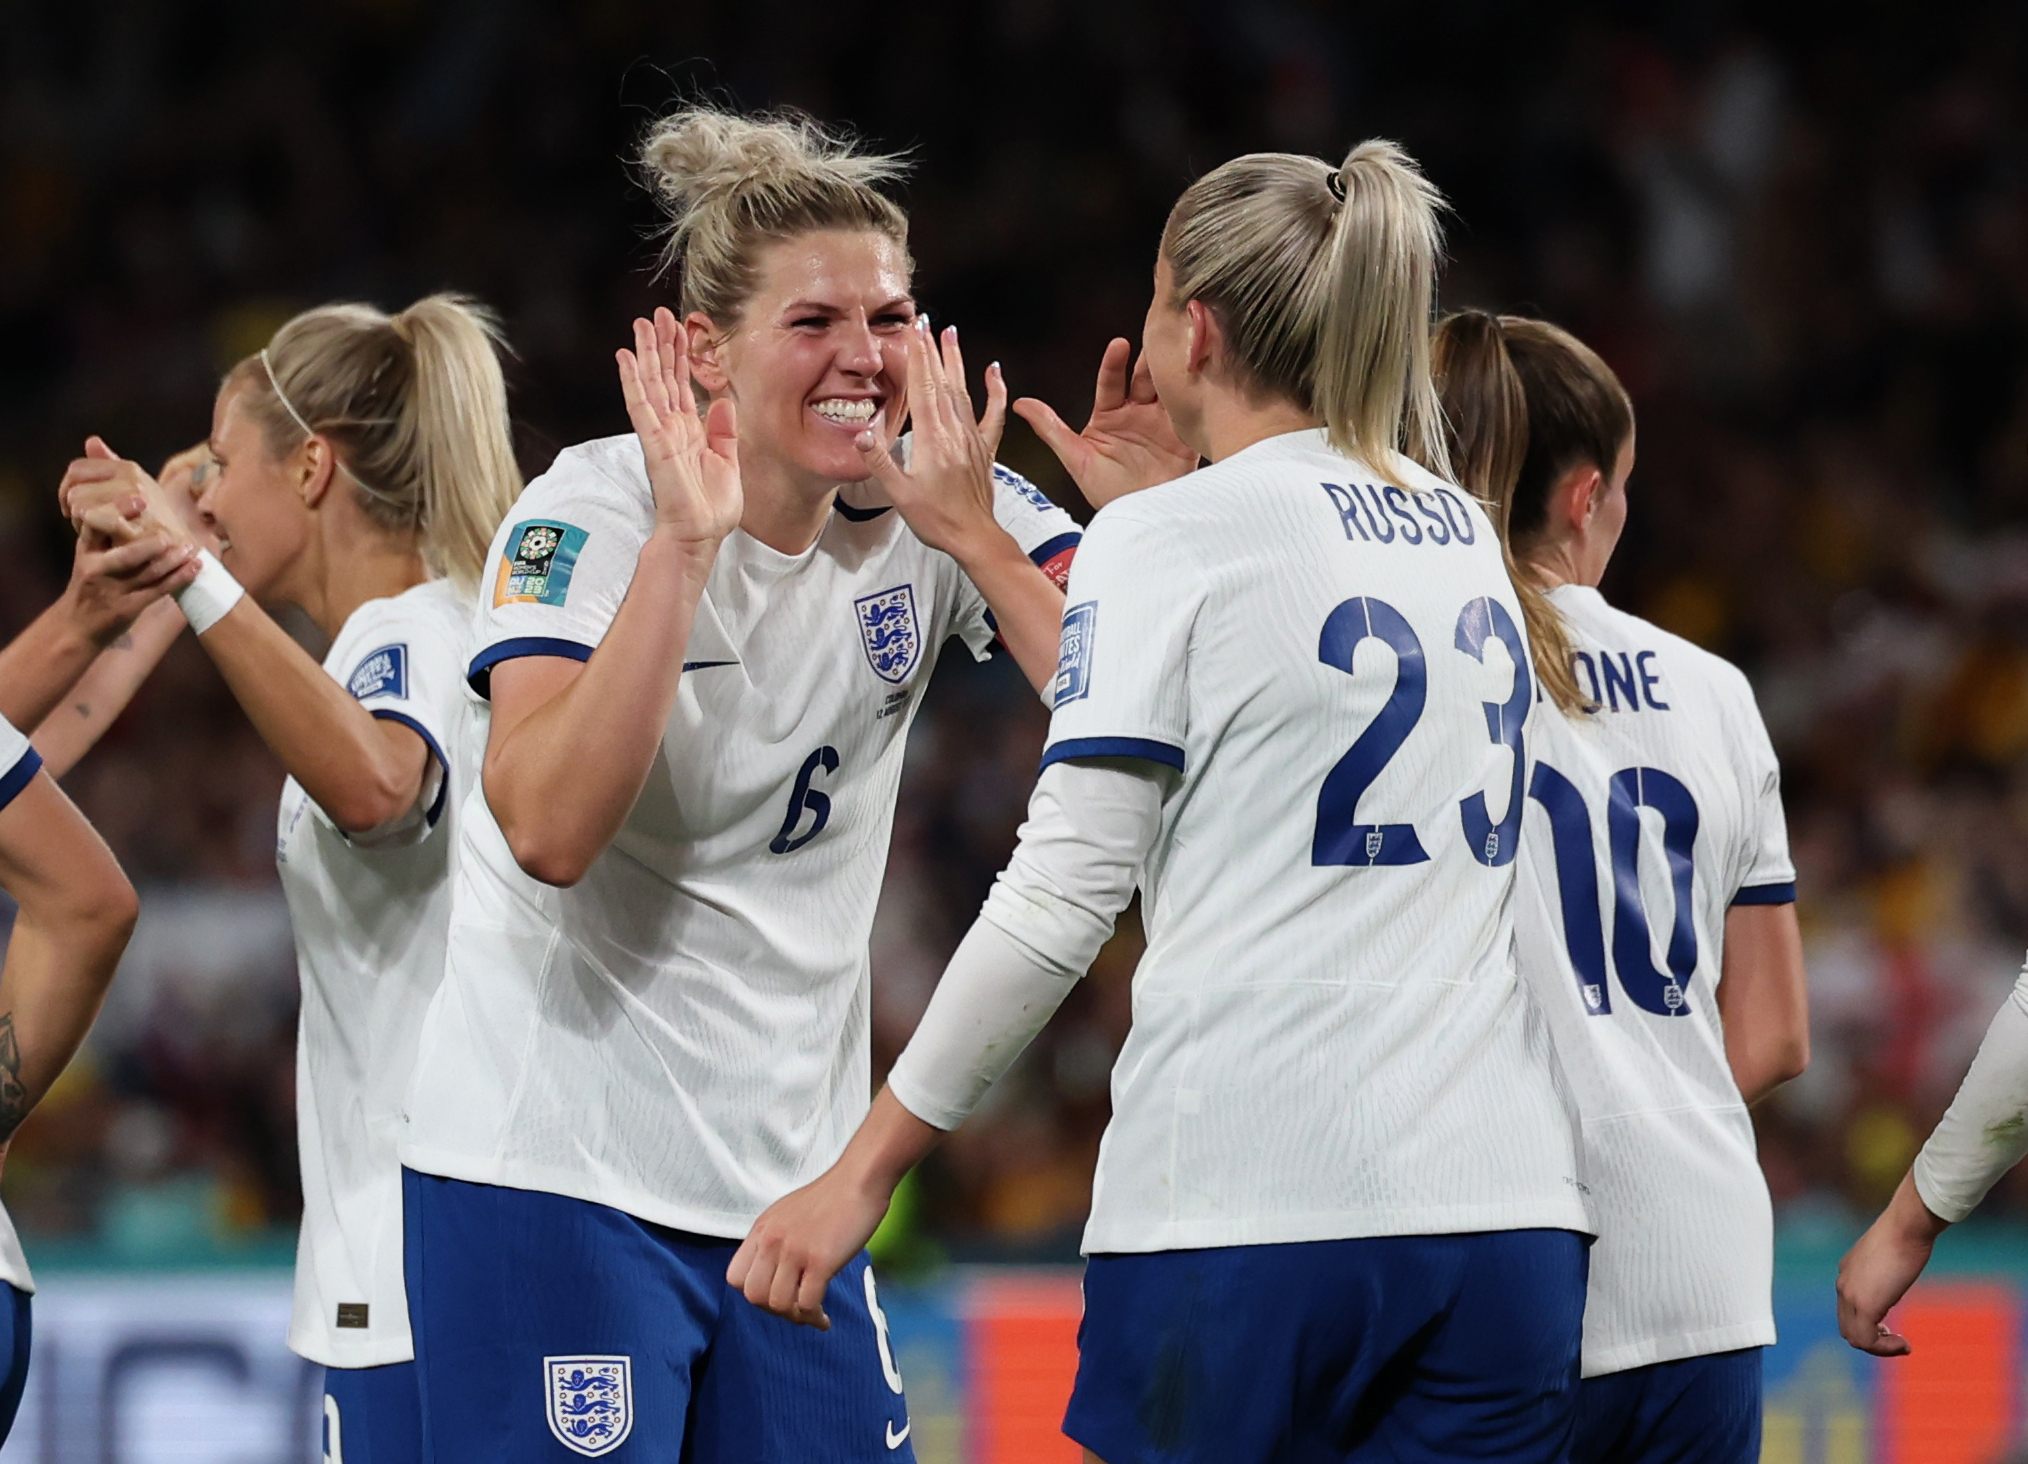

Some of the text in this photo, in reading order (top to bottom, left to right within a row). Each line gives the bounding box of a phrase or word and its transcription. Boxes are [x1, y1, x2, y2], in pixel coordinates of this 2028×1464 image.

[1320, 483, 1474, 546] RUSSO
[525, 585, 543, 594] 23
[527, 577, 545, 586] 20
[1536, 650, 1671, 714] ONE
[1311, 596, 1534, 867] 23
[769, 745, 840, 855] 6
[1528, 760, 1700, 1017] 10
